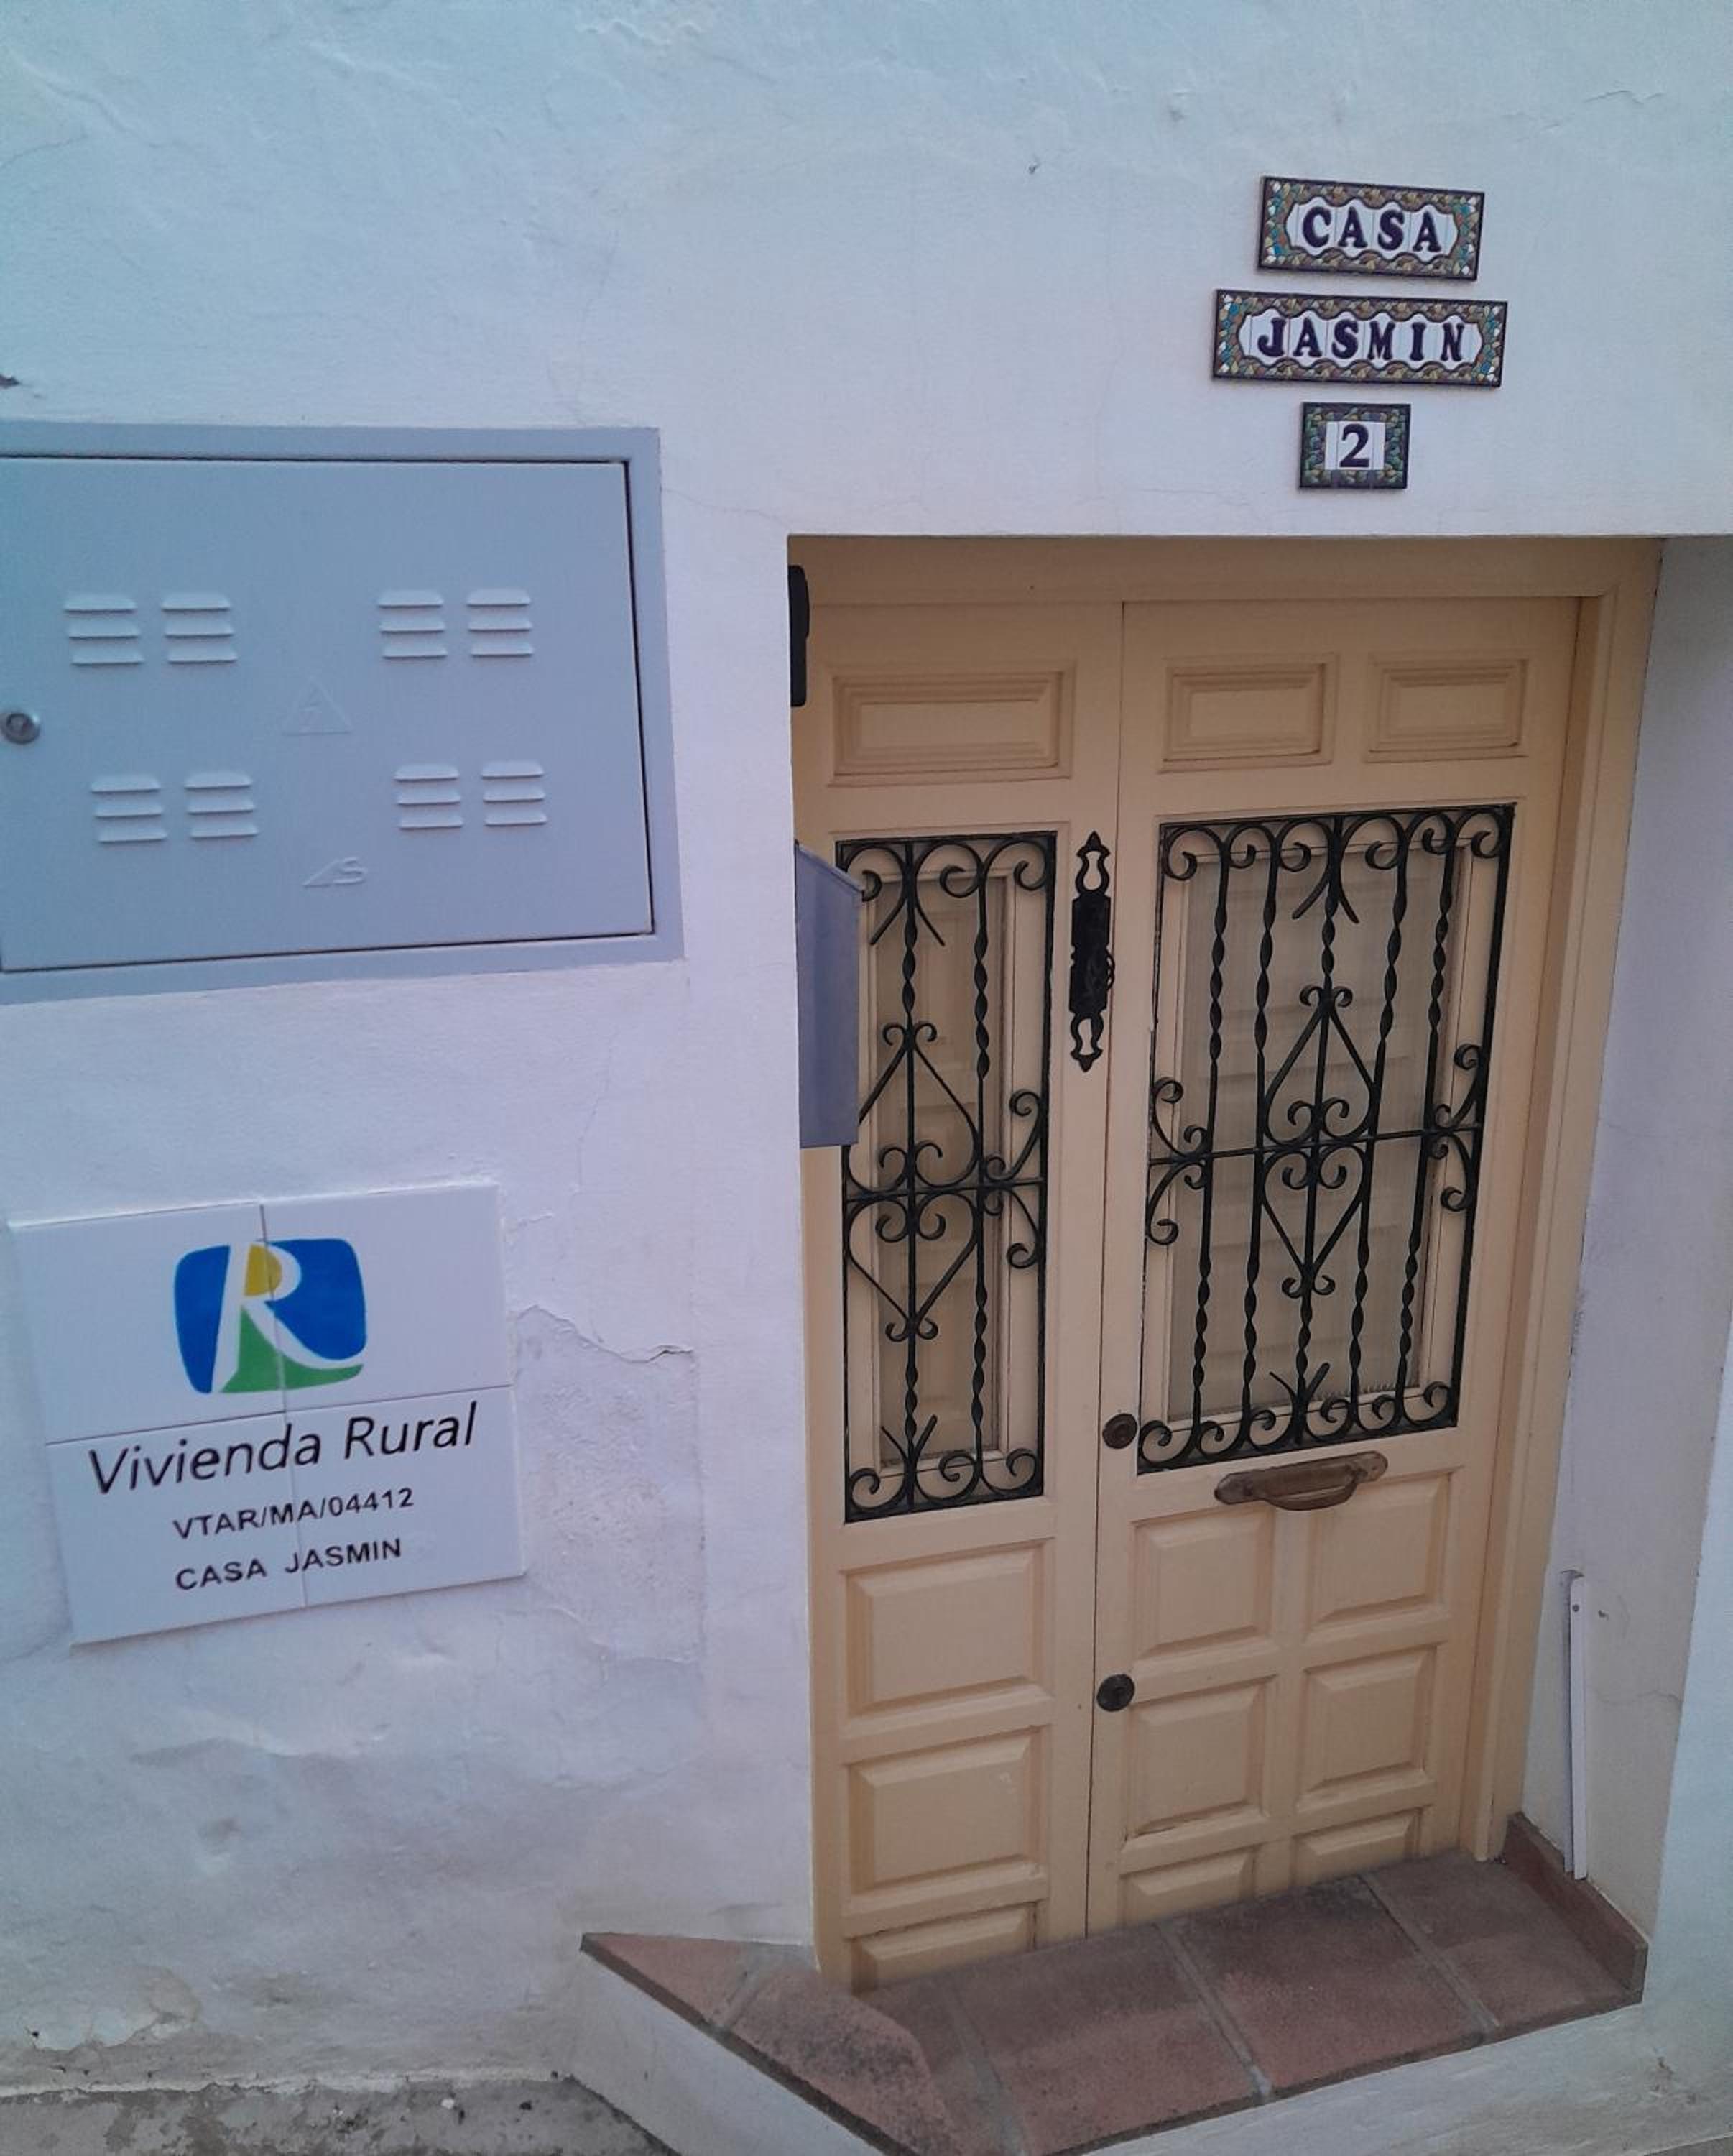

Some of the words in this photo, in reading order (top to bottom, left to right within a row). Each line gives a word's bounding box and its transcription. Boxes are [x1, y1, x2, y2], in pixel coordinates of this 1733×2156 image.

[1302, 206, 1441, 252] CASA
[1257, 317, 1466, 361] JASMIN
[1339, 423, 1370, 469] 2
[88, 1424, 321, 1495] Vivienda
[344, 1401, 476, 1460] Rural
[173, 1488, 415, 1539] VTAR/MA/04412
[176, 1559, 267, 1590] CASA
[285, 1539, 402, 1574] JASMIN
